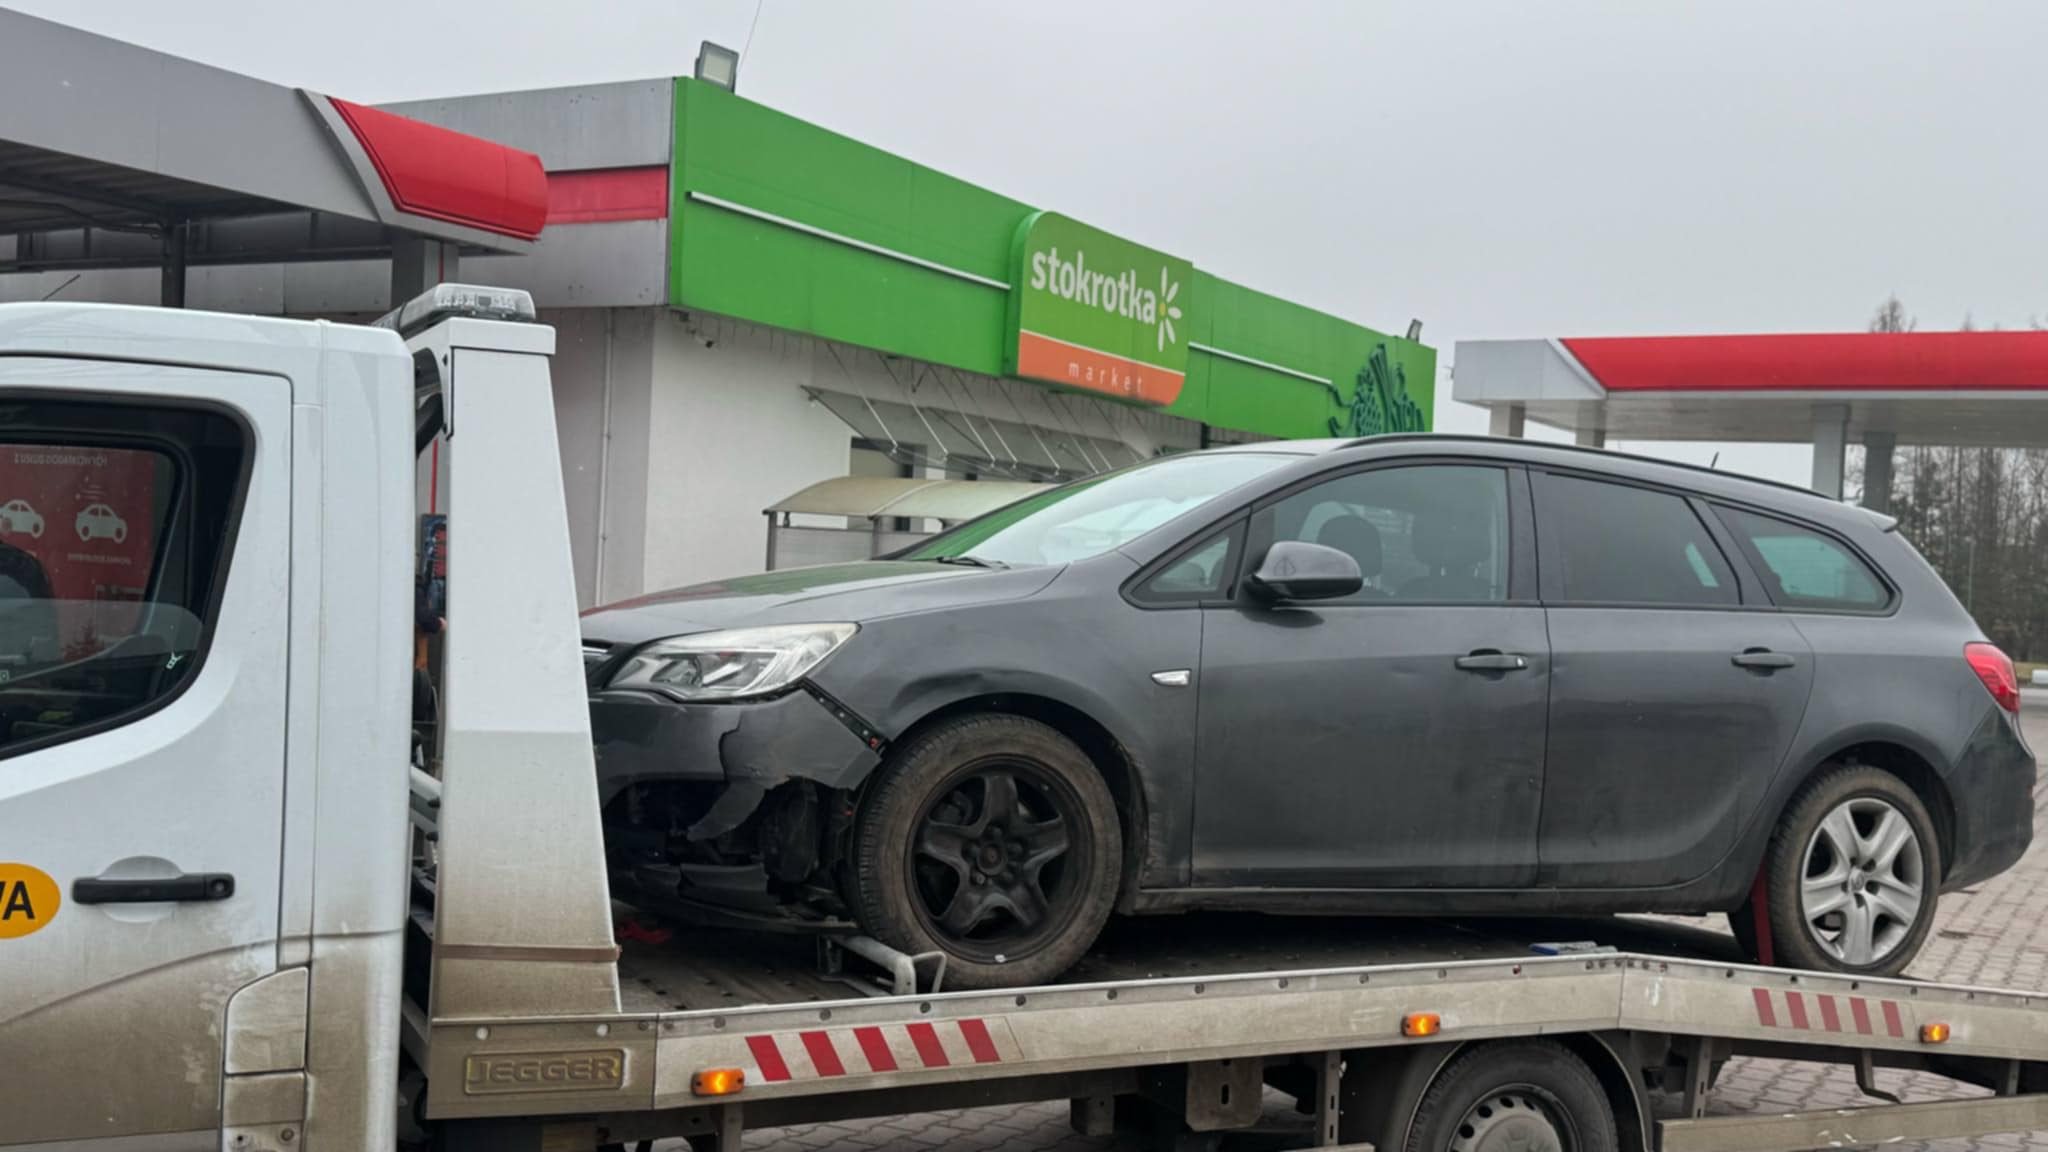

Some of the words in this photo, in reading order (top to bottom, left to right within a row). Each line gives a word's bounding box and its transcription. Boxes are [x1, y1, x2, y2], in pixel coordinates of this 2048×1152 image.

[1031, 247, 1157, 325] stokrotka
[1068, 361, 1143, 393] market
[467, 1055, 622, 1086] JEGGER
